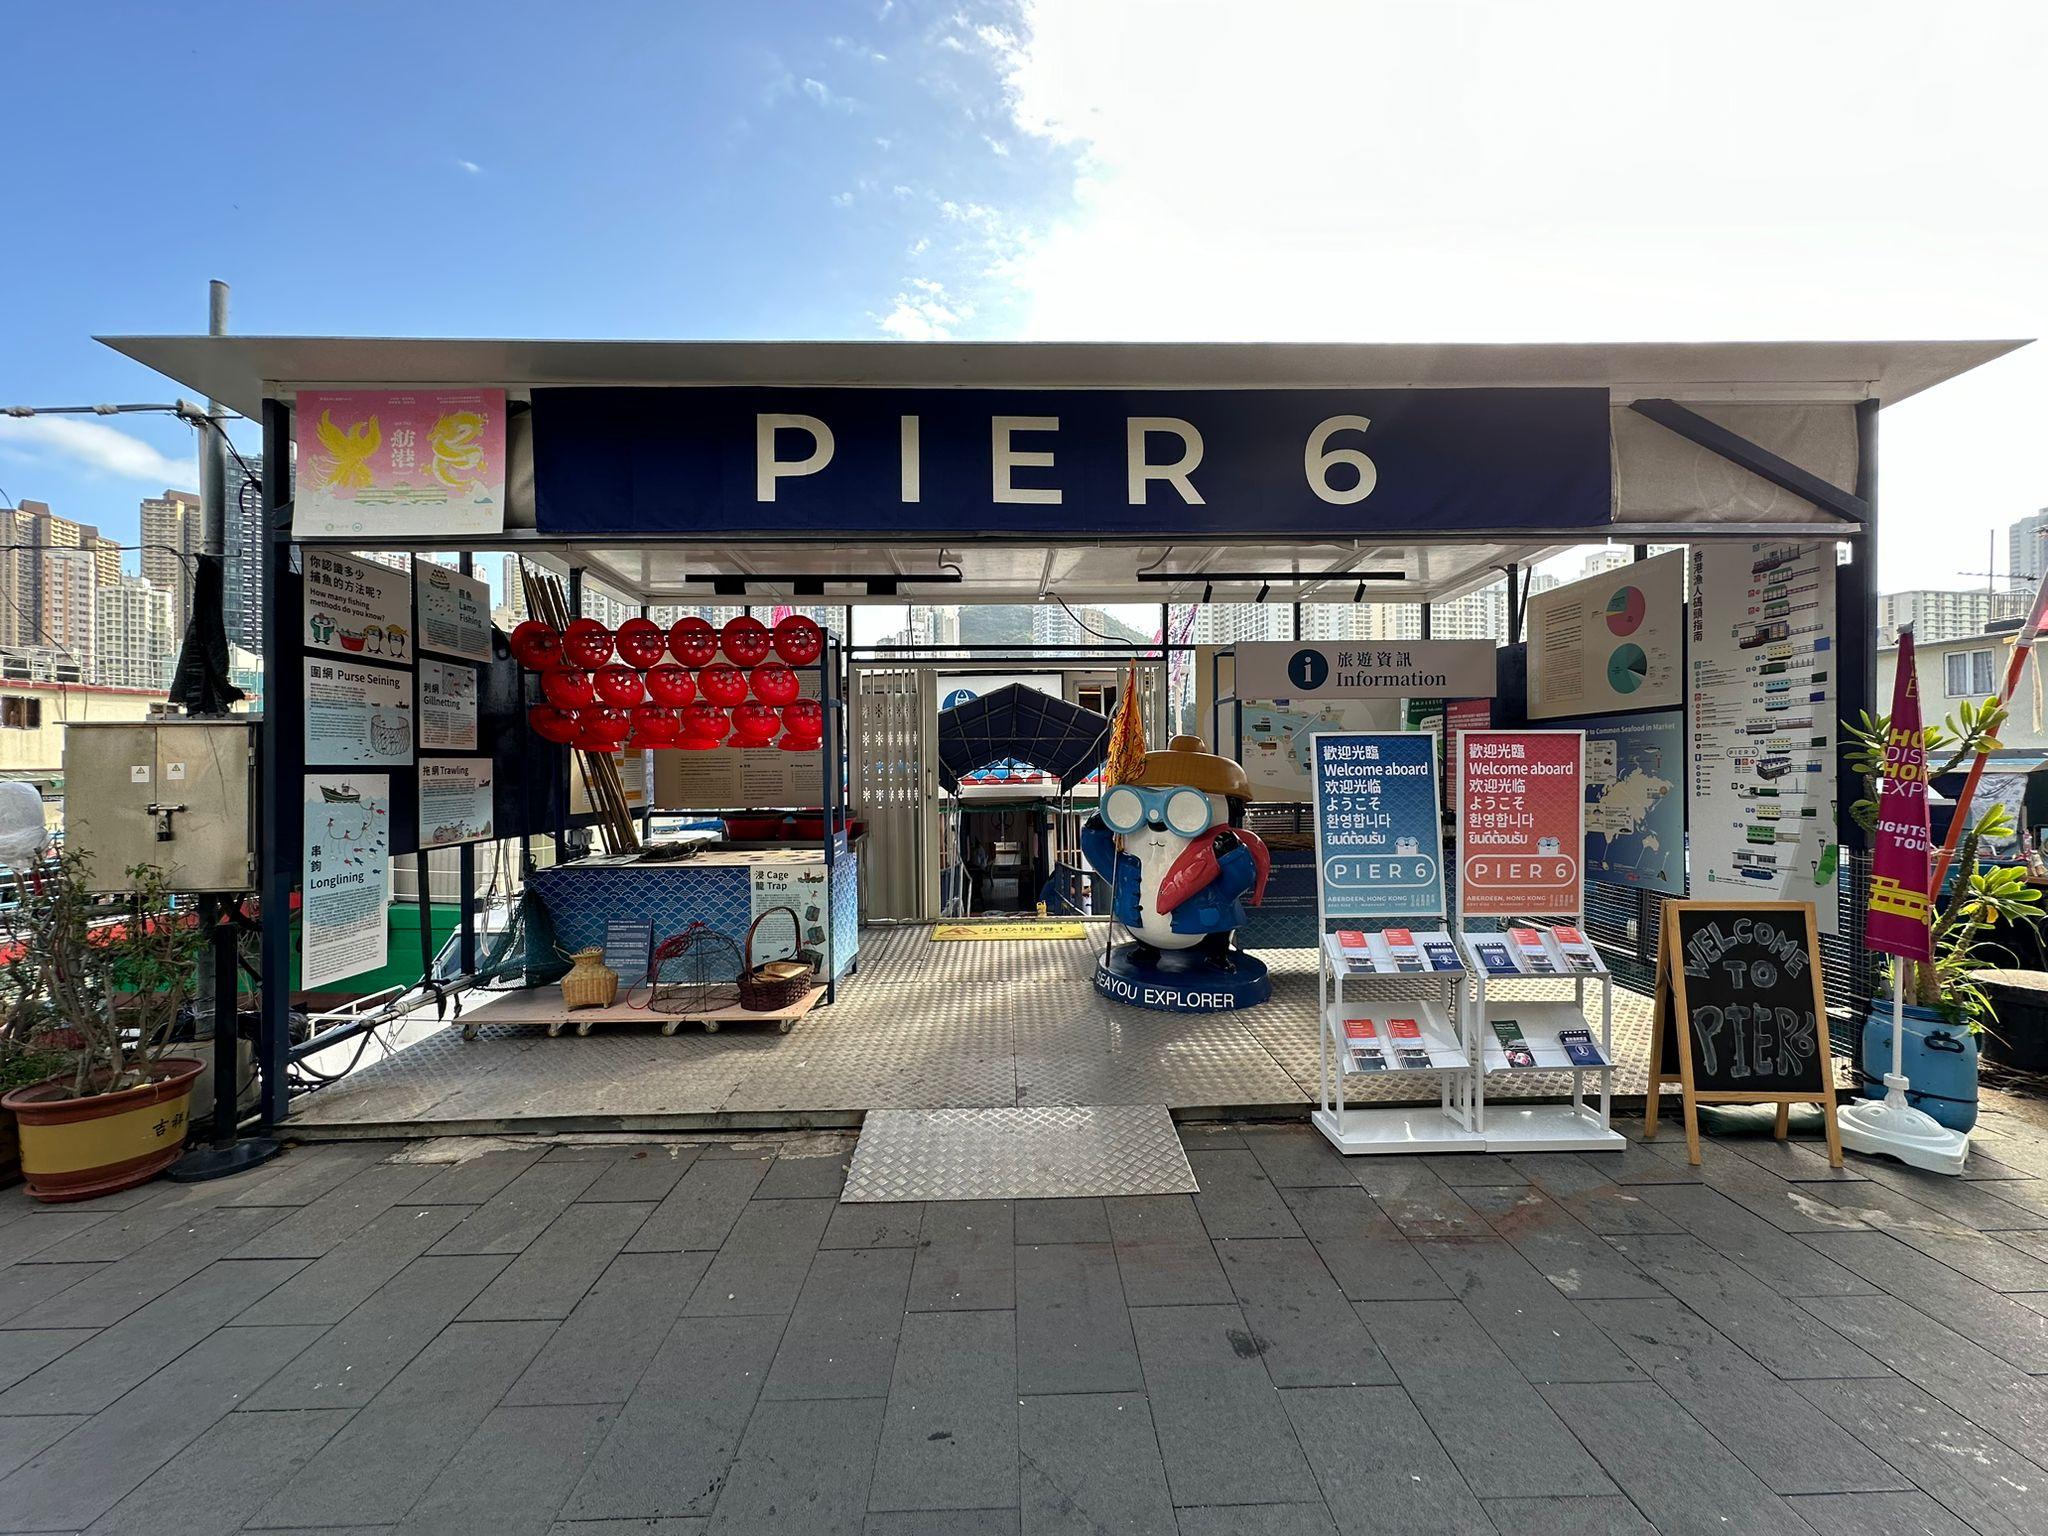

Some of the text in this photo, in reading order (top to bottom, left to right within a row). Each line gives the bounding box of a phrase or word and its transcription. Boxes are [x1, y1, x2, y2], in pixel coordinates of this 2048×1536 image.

[757, 413, 1378, 505] PIER 6
[309, 554, 365, 580] 你認識多少
[310, 587, 370, 610] How many fishing
[310, 598, 386, 622] methods do you know?
[459, 601, 477, 614] Lamp
[1336, 651, 1412, 668] 旅遊資訊
[337, 670, 400, 690] Purse Seining
[1336, 669, 1447, 687] Information
[423, 695, 461, 710] Gillnetting
[1596, 727, 1620, 735] Common
[1621, 725, 1645, 733] Seafood
[1652, 723, 1675, 731] Market
[1322, 745, 1380, 760] 歡迎光臨
[1469, 743, 1525, 759] 歡迎光臨
[440, 765, 469, 776] Trawling
[1323, 762, 1429, 777] Welcome aboard
[1469, 761, 1574, 775] Welcome aboard
[1325, 780, 1382, 795] 欢迎光临
[1469, 778, 1526, 794] 欢迎光临
[1326, 797, 1381, 811] ようこそ
[1469, 796, 1525, 811] ようこそ
[1326, 813, 1391, 829] 환영합니다
[1469, 812, 1534, 828] 환영합니다
[1327, 830, 1386, 845] ยินดีต้อนรับ
[1469, 830, 1528, 844] ยินดีต้อนรับ
[766, 870, 789, 881] Cage
[1334, 864, 1402, 879] PIER
[1415, 863, 1427, 878] 6
[1475, 863, 1567, 879] PIER 6
[310, 872, 365, 890] Longlining
[767, 881, 788, 892] Trap
[1684, 917, 1809, 980] WELCOME
[1722, 959, 1778, 989] TO
[1096, 970, 1235, 1008] SEAYOU EXPLORER
[1692, 1002, 1816, 1079] PIER 6
